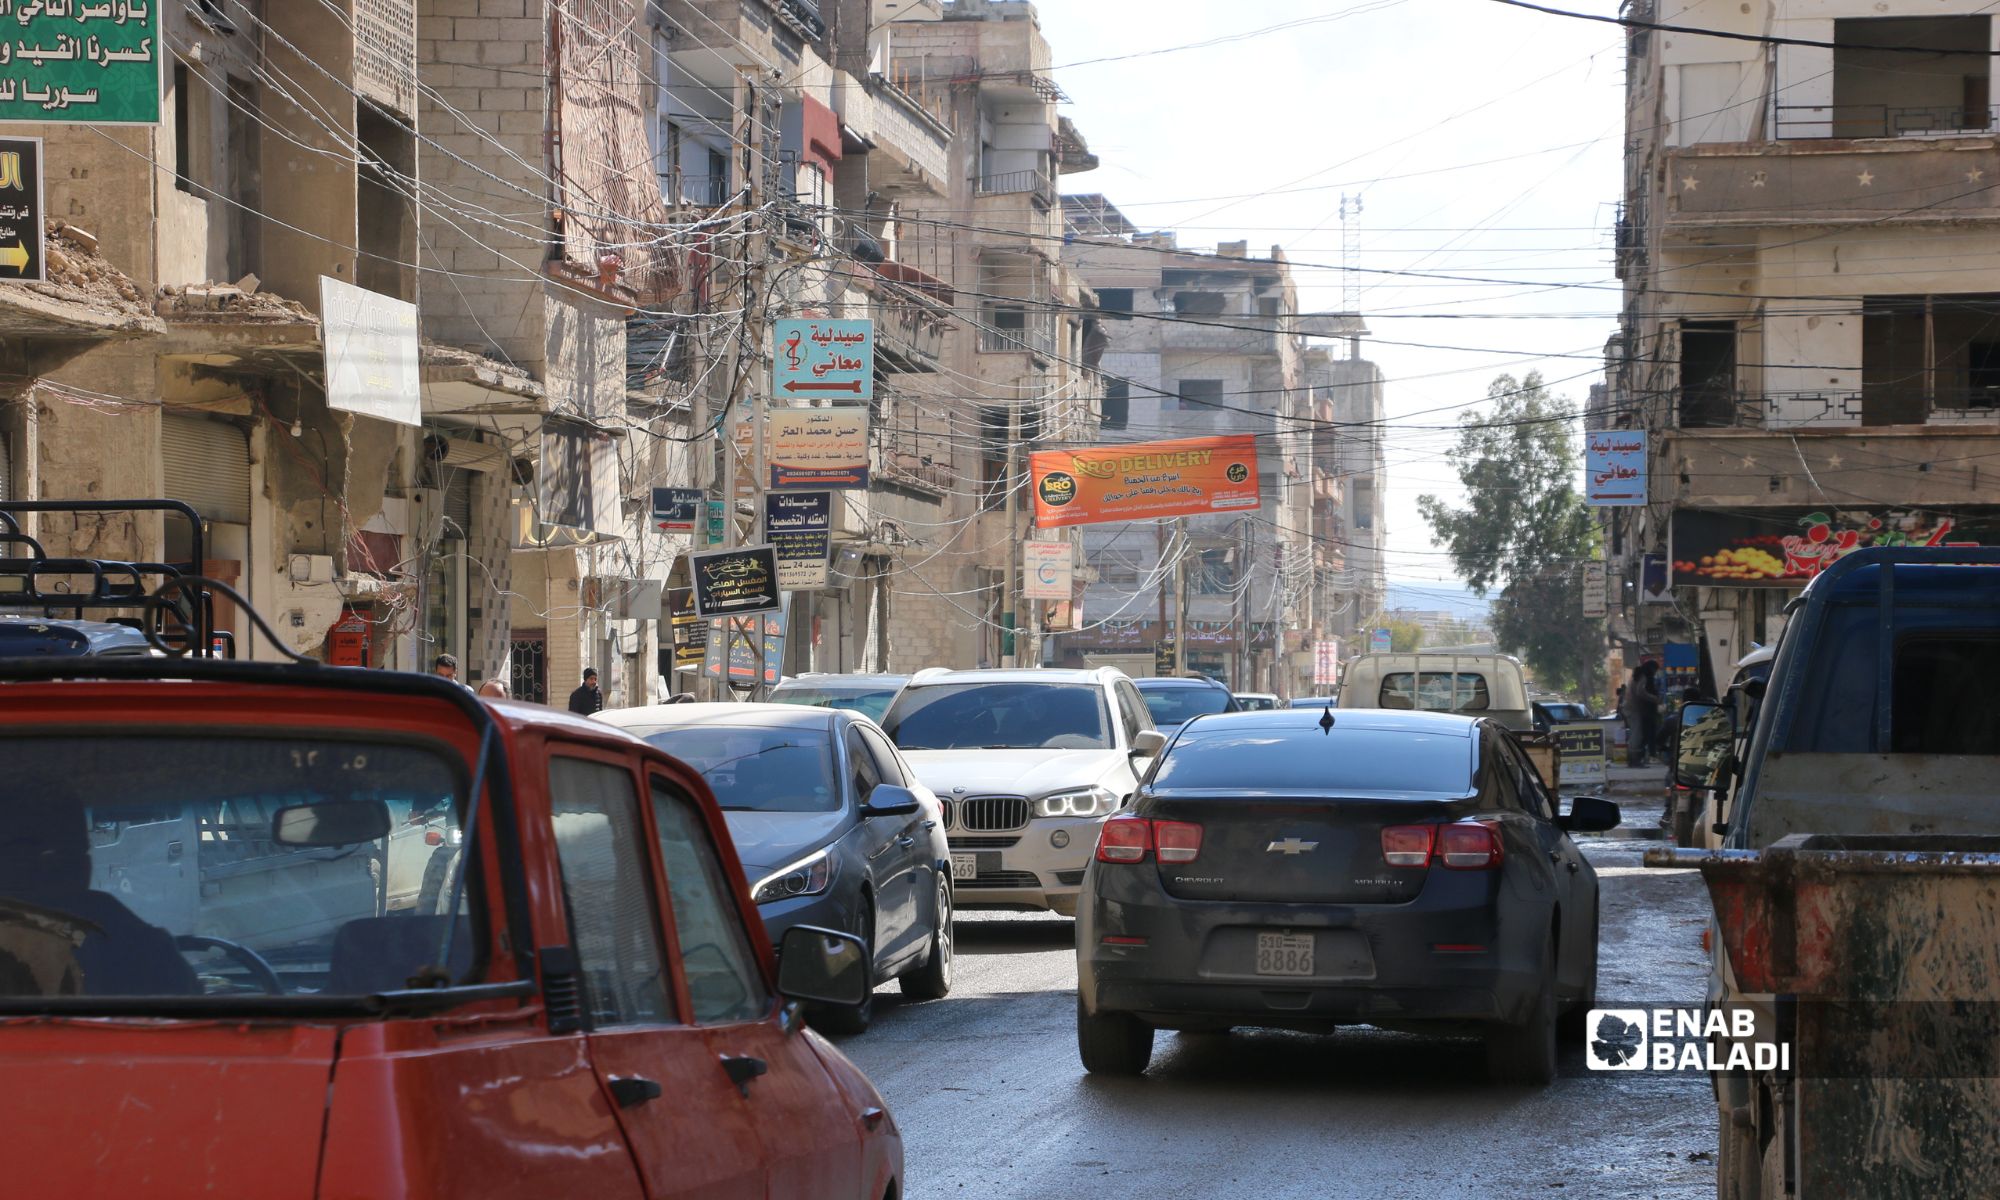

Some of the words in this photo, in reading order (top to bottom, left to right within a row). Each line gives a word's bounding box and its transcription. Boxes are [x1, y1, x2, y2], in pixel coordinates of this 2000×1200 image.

[16, 33, 81, 66] القيد
[87, 34, 151, 67] كسرنا
[22, 79, 98, 109] سوريا
[810, 324, 865, 347] صيدلية
[812, 351, 862, 376] معاني
[806, 415, 833, 424] الدكتور
[806, 427, 832, 436] محمد
[835, 426, 859, 437] حسن
[1590, 435, 1642, 457] صيدلية
[1071, 454, 1118, 478] BRO
[1121, 449, 1213, 473] DELIVERY
[1594, 462, 1638, 487] معاني
[1044, 477, 1072, 493] BRO
[671, 491, 702, 506] صيدلية
[779, 495, 819, 509] عيادات
[770, 513, 806, 529] التخصصية
[793, 561, 803, 569] 24
[706, 579, 735, 592] الملكي
[710, 588, 741, 598] السيارات
[1175, 876, 1224, 884] CHEVROLET
[1260, 949, 1310, 972] 8886
